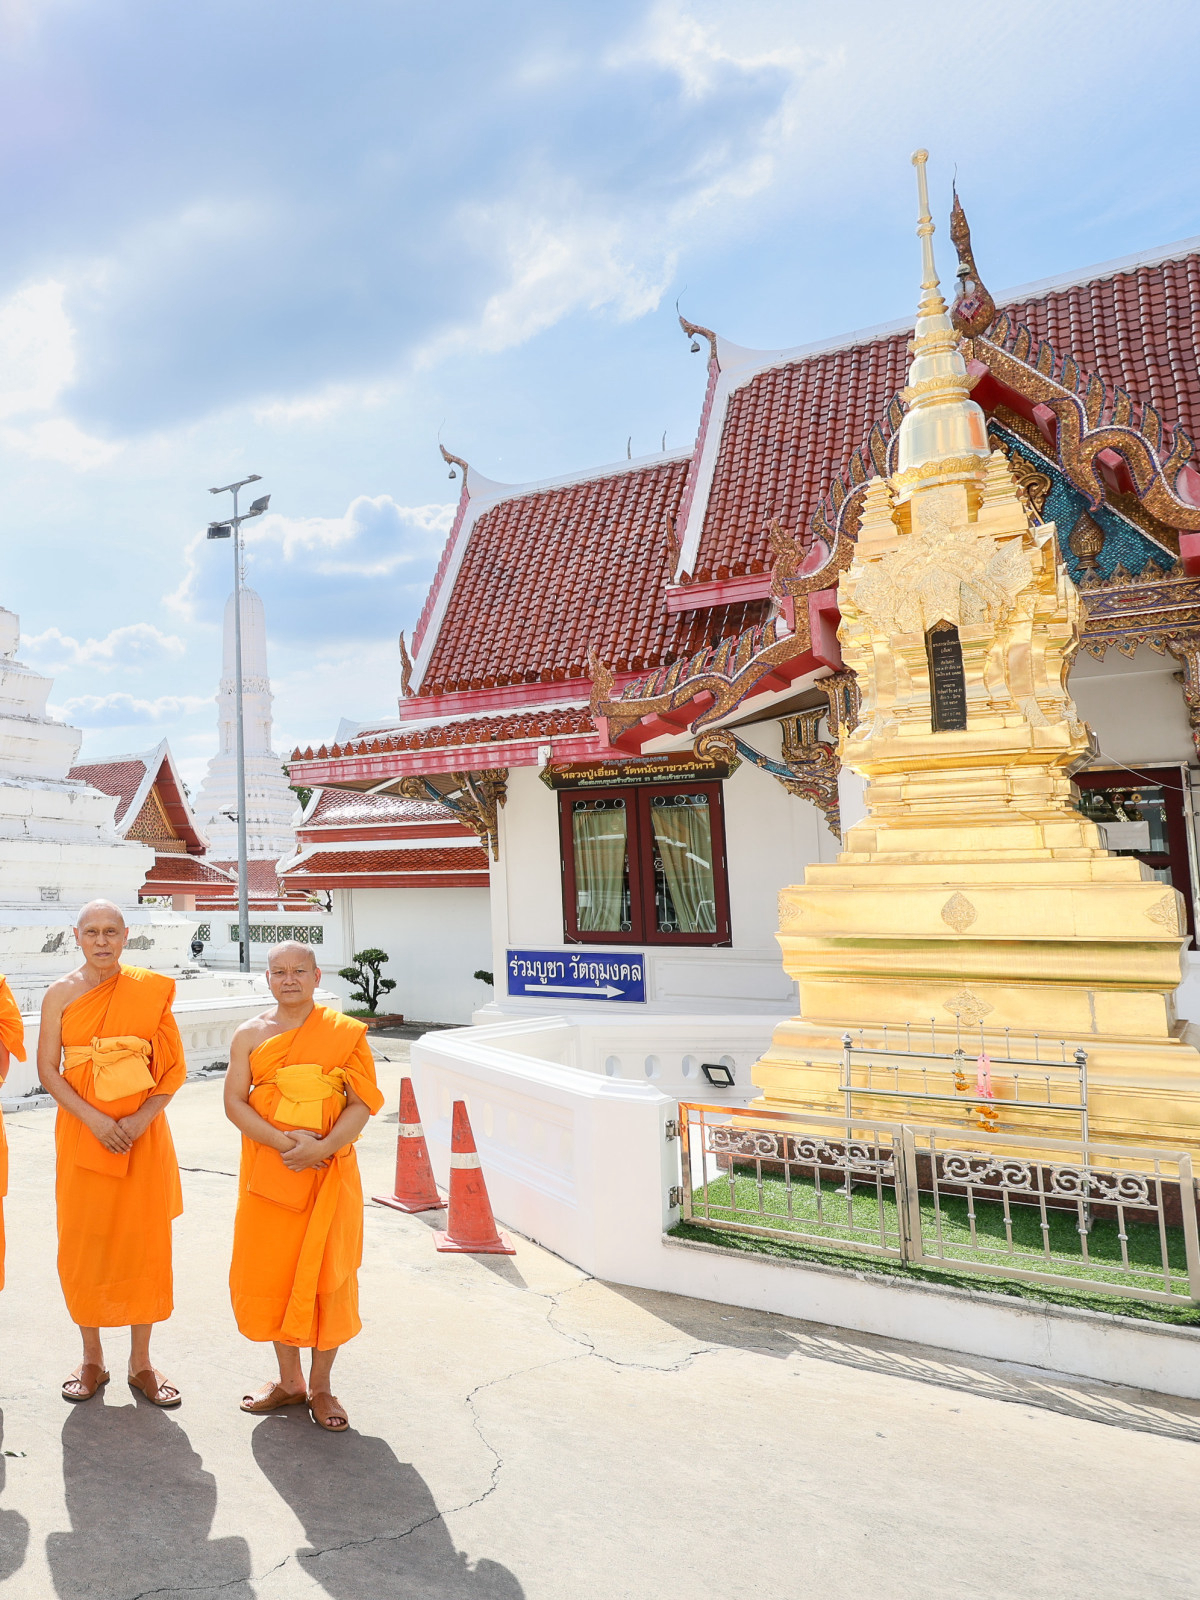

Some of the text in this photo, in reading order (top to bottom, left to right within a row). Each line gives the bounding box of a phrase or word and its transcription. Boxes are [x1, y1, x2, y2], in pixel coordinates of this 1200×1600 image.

[561, 766, 618, 780] หลวงปู่เอี่ยม
[623, 761, 716, 776] วัดหนังราชวรวิหาร
[509, 954, 642, 987] ร่วมบูชา วัตถุมงคล
